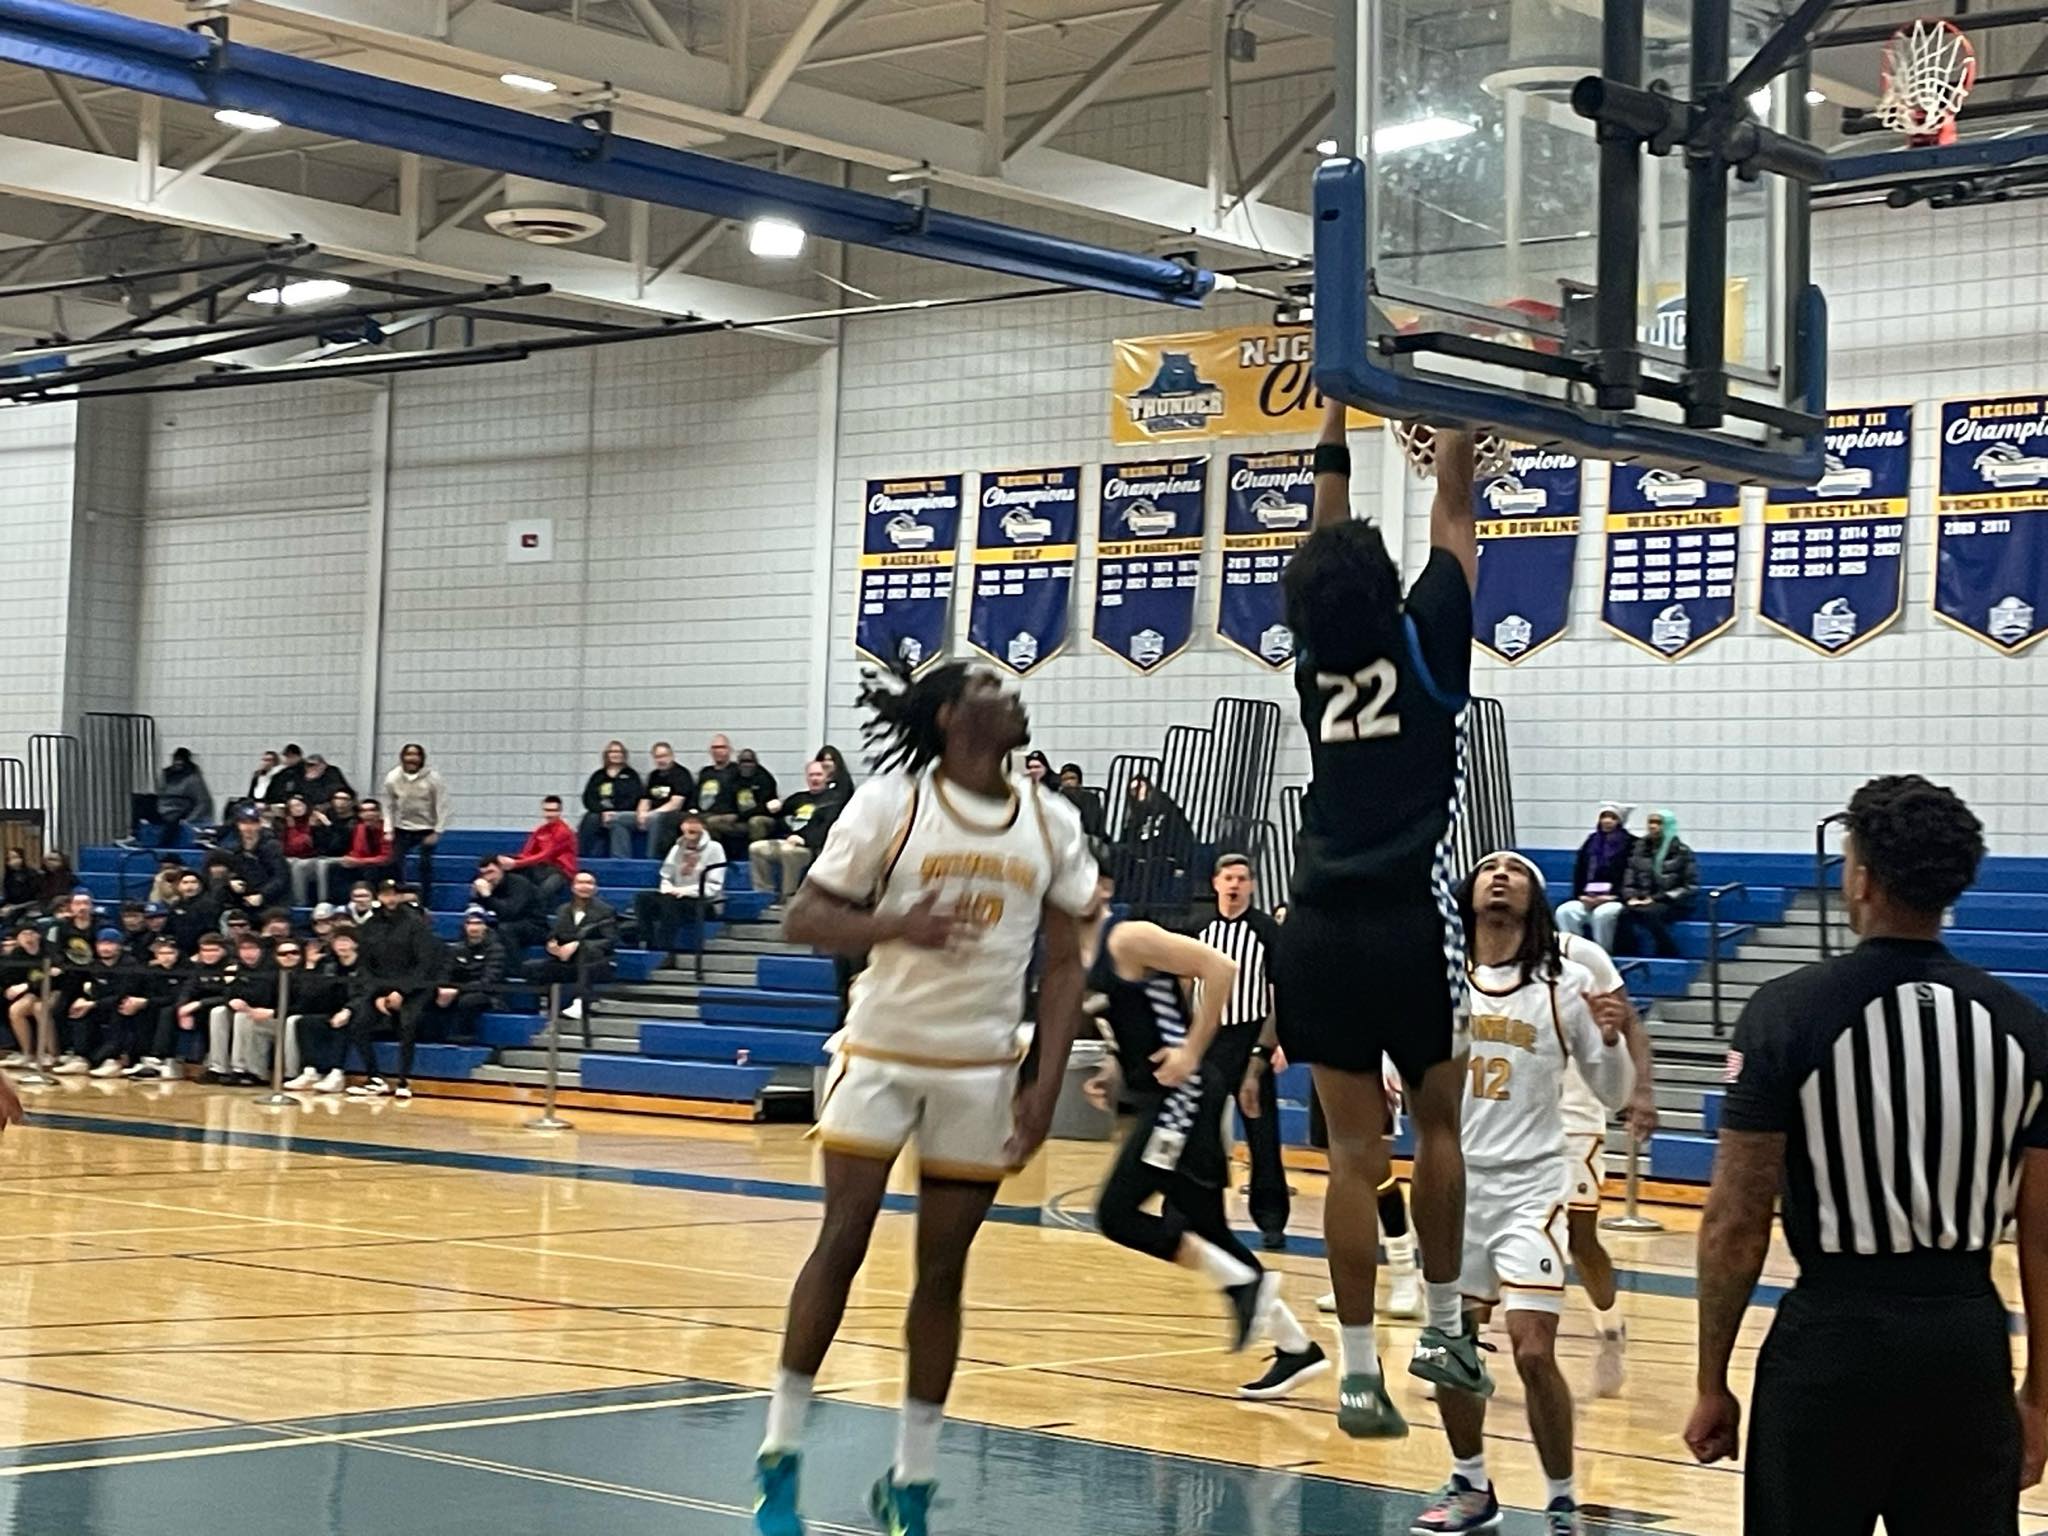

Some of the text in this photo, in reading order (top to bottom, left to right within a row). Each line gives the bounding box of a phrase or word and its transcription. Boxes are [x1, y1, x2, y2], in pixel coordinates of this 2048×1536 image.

[1240, 334, 1313, 369] NJC
[1259, 361, 1325, 416] Ch
[1827, 412, 1887, 428] ION III
[1824, 427, 1908, 456] mpions
[1103, 477, 1202, 500] Champions
[1231, 466, 1315, 492] Champio
[869, 493, 958, 515] Champions
[982, 486, 1077, 509] Champions
[1627, 512, 1722, 528] WRESTLING
[1787, 502, 1890, 519] WRESTLING
[1508, 520, 1579, 534] BOWLING
[1317, 658, 1400, 743] 22
[1468, 1055, 1511, 1101] 12
